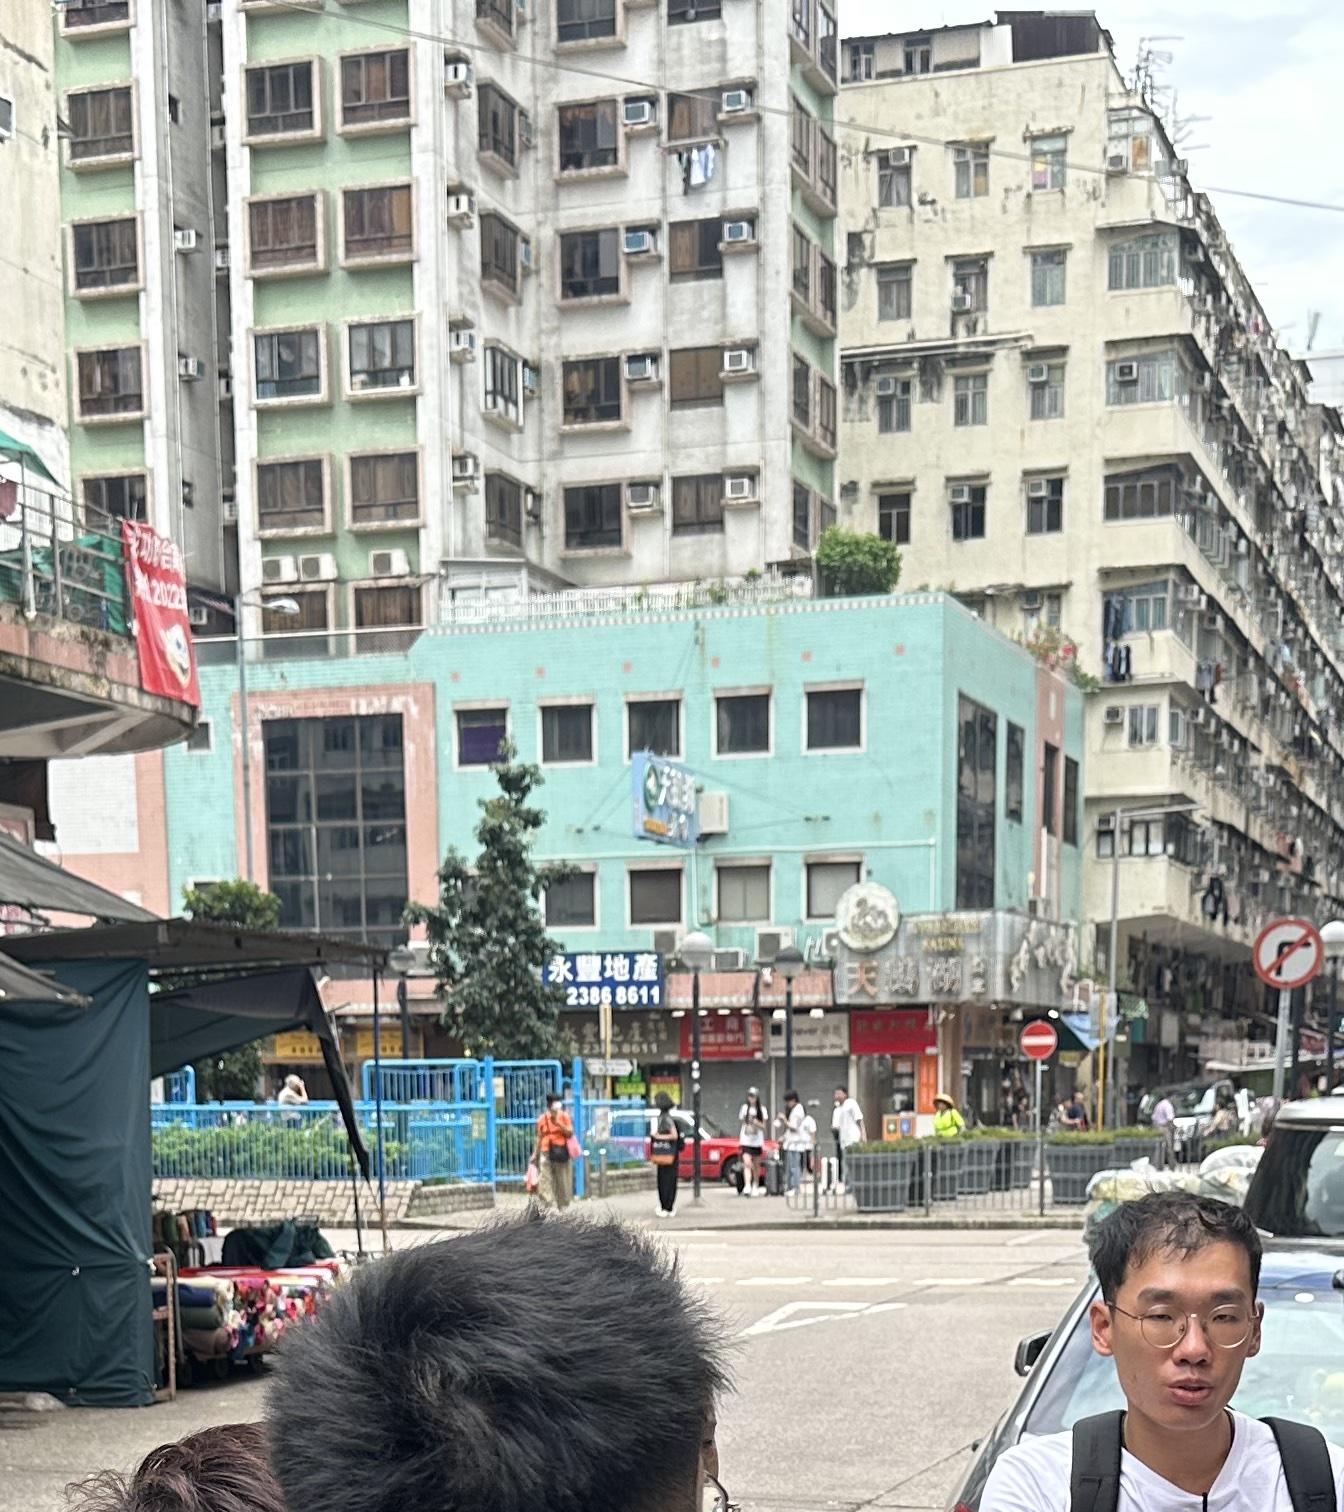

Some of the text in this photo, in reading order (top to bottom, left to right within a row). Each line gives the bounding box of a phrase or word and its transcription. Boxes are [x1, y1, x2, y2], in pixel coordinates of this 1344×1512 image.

[548, 953, 659, 984] 永豐地產
[566, 984, 660, 1006] 2386 8611
